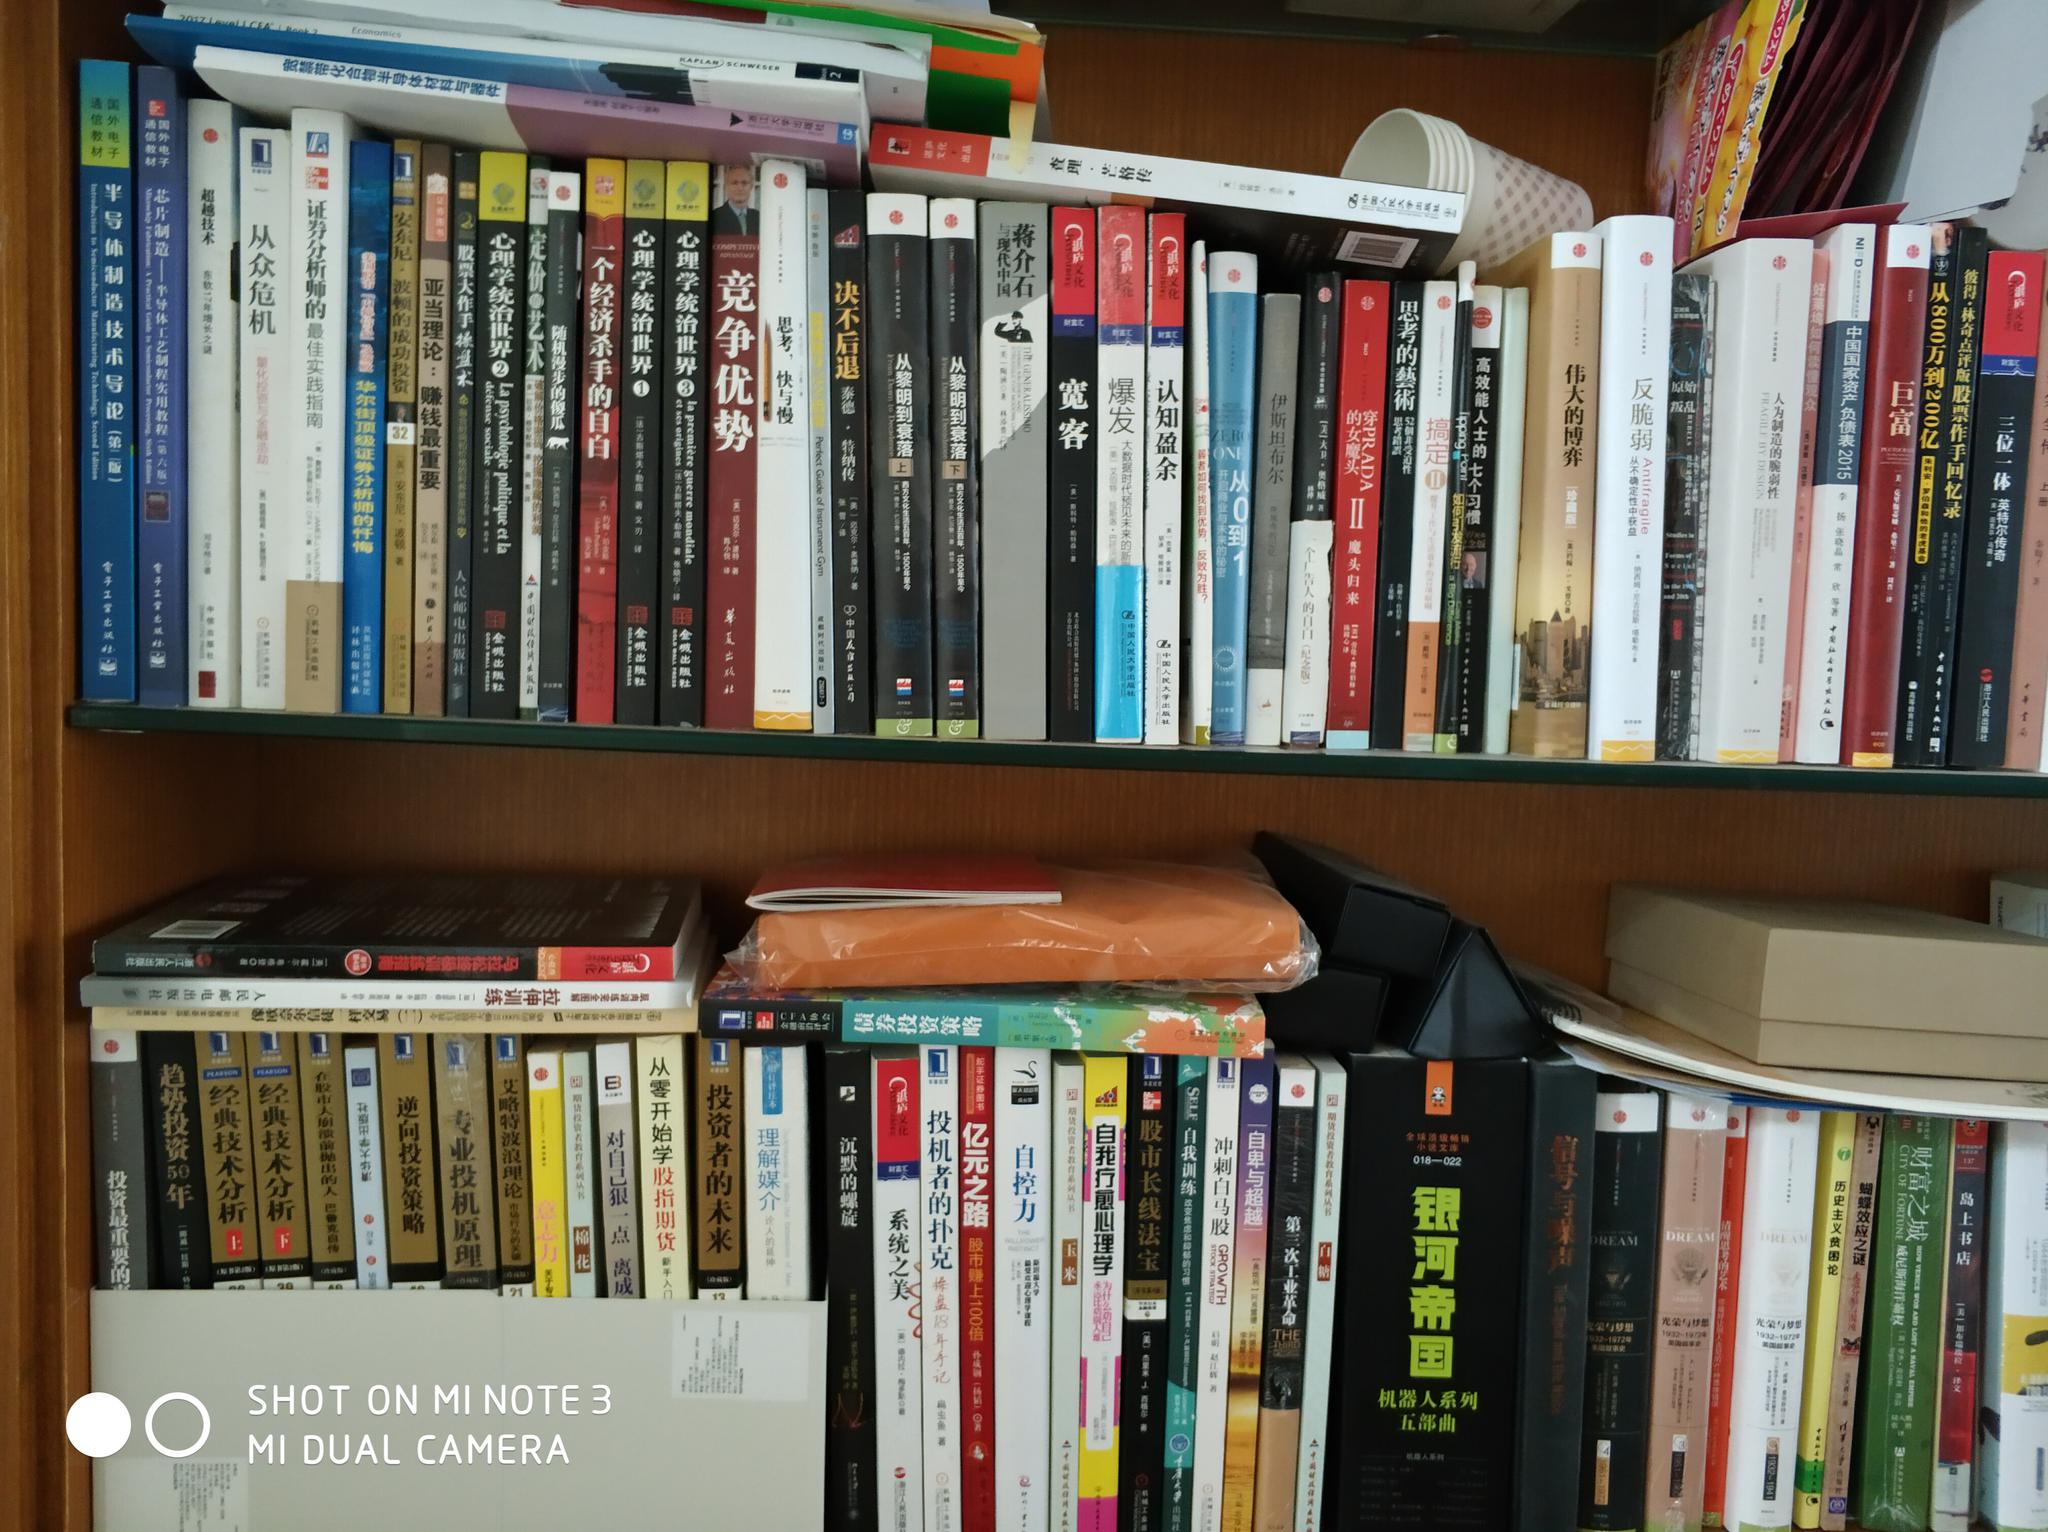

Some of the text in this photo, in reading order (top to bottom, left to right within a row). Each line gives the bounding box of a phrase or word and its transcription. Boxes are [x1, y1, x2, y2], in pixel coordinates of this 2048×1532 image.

[351, 26, 402, 39] Economics
[90, 97, 103, 158] 通信教材
[107, 97, 120, 158] 国外电子
[145, 120, 157, 168] 通信教材
[158, 120, 170, 168] 国外电子
[90, 184, 98, 234] Introduction
[200, 188, 215, 245] 超越技术
[1361, 194, 1441, 214] 中国人民大学出版社
[90, 247, 98, 308] Semiconductor
[248, 224, 276, 335] 从众危机
[996, 223, 1012, 298] 与现代中国
[1012, 223, 1036, 298] 蒋介石
[89, 310, 99, 369] Manufacturing
[455, 244, 475, 388] 股票大作手操盘术
[588, 245, 615, 460] 一个经济杀手的自白
[835, 280, 861, 381] 决不后退
[1955, 268, 1979, 384] 彼得·林奇点评版
[551, 324, 569, 431] 随机漫步的傻瓜
[713, 269, 758, 453] 竞争优势
[1393, 300, 1420, 412] 思考的藝術
[1672, 380, 1697, 394] 原始
[1919, 280, 1951, 451] 从800万到200亿
[392, 425, 409, 440] 32
[894, 353, 914, 460] 从黎明到衰落
[950, 356, 968, 461] 从黎明到衰落
[1058, 377, 1090, 450] 宽客
[1107, 377, 1137, 435] 爆发
[1155, 379, 1179, 481] 认知盈余
[1268, 393, 1288, 484] 伊斯坦布尔
[1563, 364, 1587, 468] 伟大的博弈
[1629, 378, 1655, 451] 反脆弱
[1670, 399, 1696, 413] 叛乱
[1836, 325, 1863, 481] 中国国家资产负债表2015
[1888, 380, 1917, 438] 巨富
[91, 451, 99, 481] Edition
[353, 380, 377, 554] 华尔街顶级证券分析师的忏悔
[485, 426, 495, 466] sociale
[493, 382, 514, 554] La psychologie politique et la
[673, 426, 684, 467] origines
[815, 436, 824, 466] Perfect
[896, 462, 908, 474] 上
[950, 465, 961, 476] 下
[1344, 409, 1362, 476] 的女魔头
[1360, 409, 1379, 492] 穿PRADA
[1424, 416, 1451, 466] 搞定
[1466, 357, 1492, 526] 高效能人士的七个习惯
[1767, 392, 1785, 500] 人为制造的脆弱性
[1943, 385, 1971, 519] 股票作手回忆录
[1993, 415, 2015, 492] 三位一体
[684, 400, 698, 565] la première guerre mondiale
[815, 469, 825, 496] Guide
[1627, 456, 1639, 536] 从不确定性中获益
[1639, 457, 1654, 535] Antifragile
[816, 508, 825, 554] Instrument
[1228, 470, 1249, 577] 从0到1
[1994, 498, 2011, 563] 英特尔传奇
[815, 556, 825, 577] Gym
[1346, 539, 1362, 605] 魔头归来
[454, 568, 468, 676] 人民邮电出版社
[634, 626, 648, 687] 金城出版社
[679, 629, 693, 688] 金城出版社
[492, 632, 505, 692] 金城出版社
[1126, 623, 1136, 697] 中国人民大学出版社
[1161, 652, 1172, 726] 中国人民大学出版社
[148, 989, 267, 1002] 人民邮电出版社
[485, 987, 561, 1006] 拉伸训练
[853, 1012, 983, 1038] 债券投资策略
[206, 1067, 240, 1078] PEARSON
[256, 1067, 290, 1077] PEARSON
[1186, 1086, 1200, 1121] SELF
[208, 1084, 248, 1225] 经典技术分析
[258, 1084, 295, 1222] 经典技术分析
[315, 1071, 338, 1198] 在股市大崩溃前抛出的人
[397, 1095, 426, 1235] 逆向投资策略
[499, 1078, 523, 1199] 艾略特波浪理论
[572, 1094, 585, 1200] 期货投资者教育系列丛书
[706, 1083, 733, 1255] 投资者的未来
[757, 1128, 781, 1212] 理解媒介
[1180, 1127, 1198, 1196] 自我训练
[449, 1109, 483, 1268] 专业投机原理
[607, 1129, 630, 1245] 对自己狠一点
[840, 1136, 858, 1228] 沉默的螺旋
[927, 1109, 953, 1270] 投机者的扑克
[962, 1121, 990, 1228] 亿元之路
[1012, 1143, 1037, 1224] 自控力
[1093, 1123, 1118, 1277] 自我疗愈心理学
[1137, 1119, 1163, 1273] 股市长线法宝
[1210, 1137, 1233, 1237] 冲刺白马股
[1243, 1131, 1266, 1227] 自卑与超越
[1895, 1144, 1909, 1241] CITY FORTUNE
[1905, 1146, 1933, 1242] 财富之城
[575, 1228, 591, 1271] 棉花
[888, 1208, 911, 1301] 系统之美
[1064, 1241, 1078, 1282] 玉米
[1317, 1242, 1331, 1281] 白糖
[1665, 1230, 1715, 1243] DREAM
[1827, 1181, 1847, 1276] 历史主义贫困论
[1852, 1182, 1874, 1267] 蝴蝶效应之谜
[1956, 1192, 1974, 1266] 岛上书店
[967, 1237, 985, 1342] 股市赚上100倍
[1216, 1244, 1229, 1305] GROWTH
[1282, 1215, 1301, 1326] 第三次工业革命
[1409, 1186, 1461, 1379] 银河帝国
[1273, 1328, 1301, 1340] THE
[1662, 1317, 1710, 1328] 光荣与梦想
[1756, 1318, 1802, 1329] 光荣与梦想
[1377, 1387, 1478, 1411] 机器人系列
[1398, 1412, 1456, 1434] 五部曲
